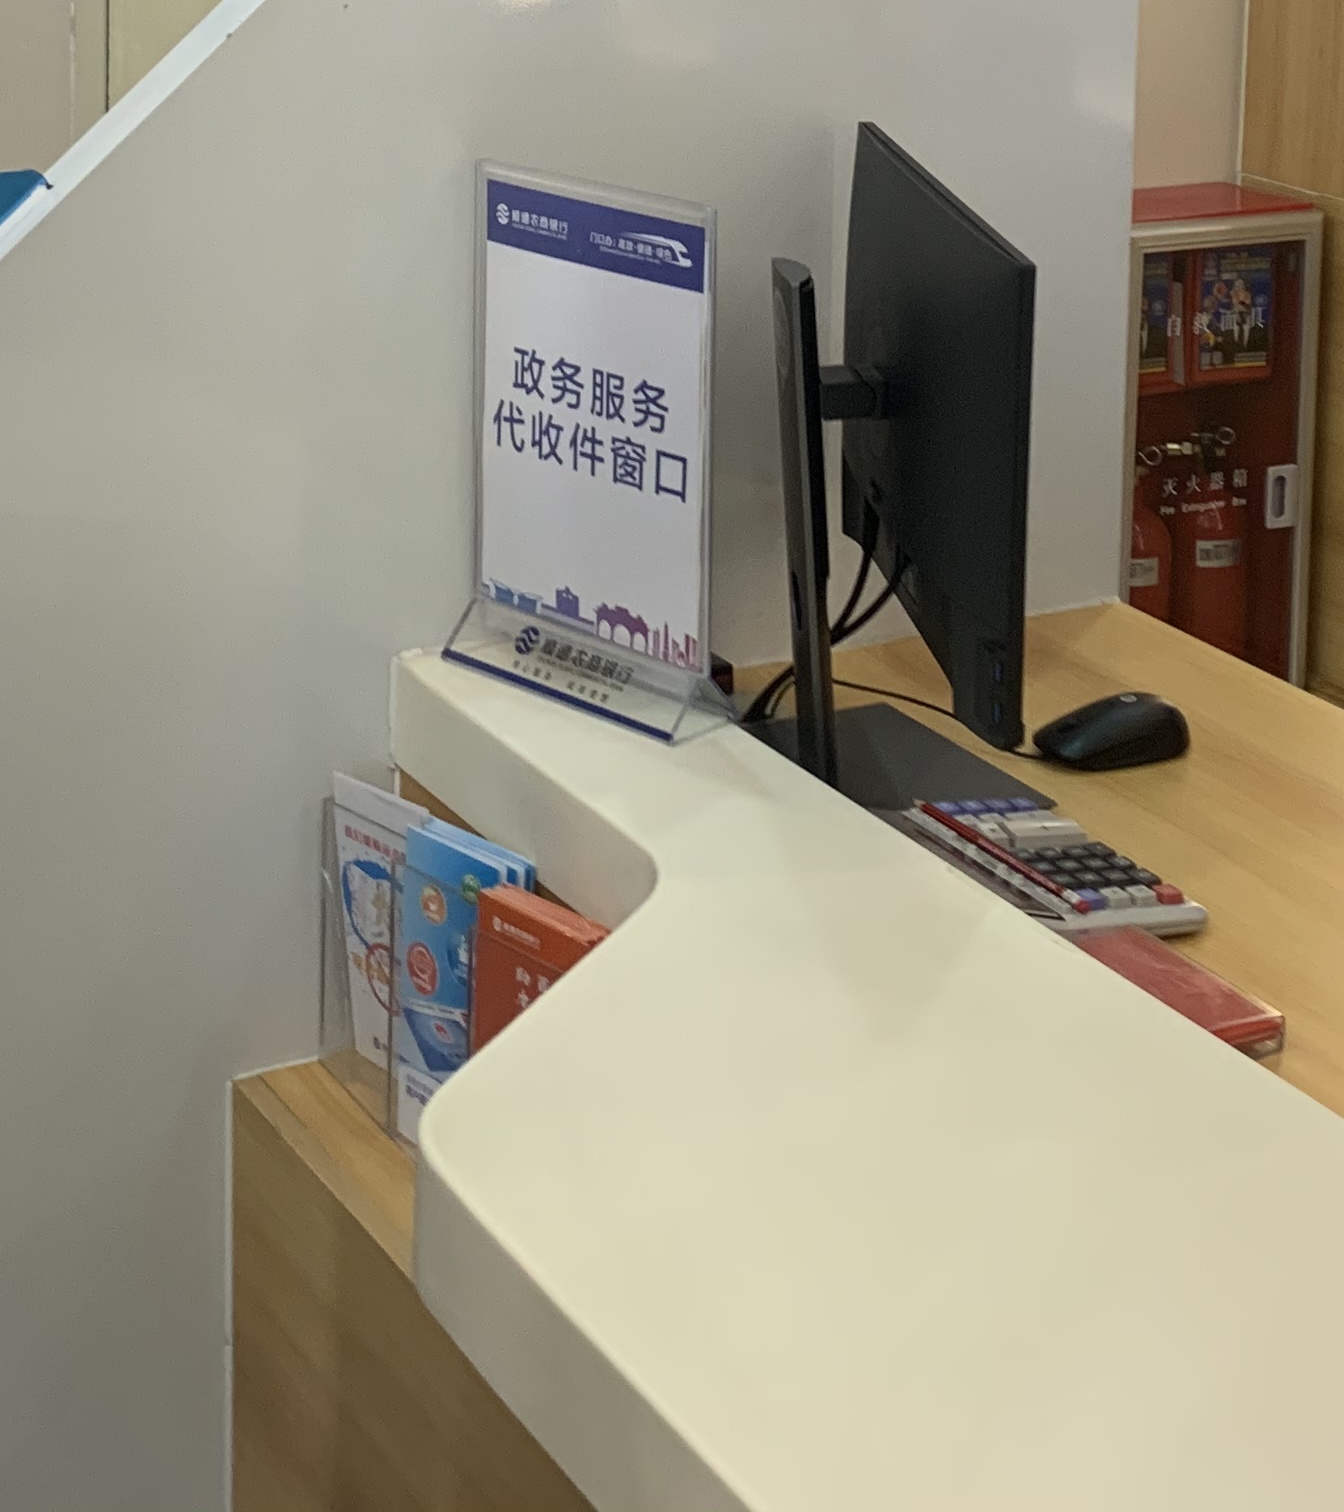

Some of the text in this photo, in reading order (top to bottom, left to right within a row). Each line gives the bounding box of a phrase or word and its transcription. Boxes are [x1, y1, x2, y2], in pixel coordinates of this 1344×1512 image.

[512, 345, 670, 435] 政务服务
[492, 398, 690, 504] 代收件窗口
[1160, 468, 1248, 498] 灭火器箱
